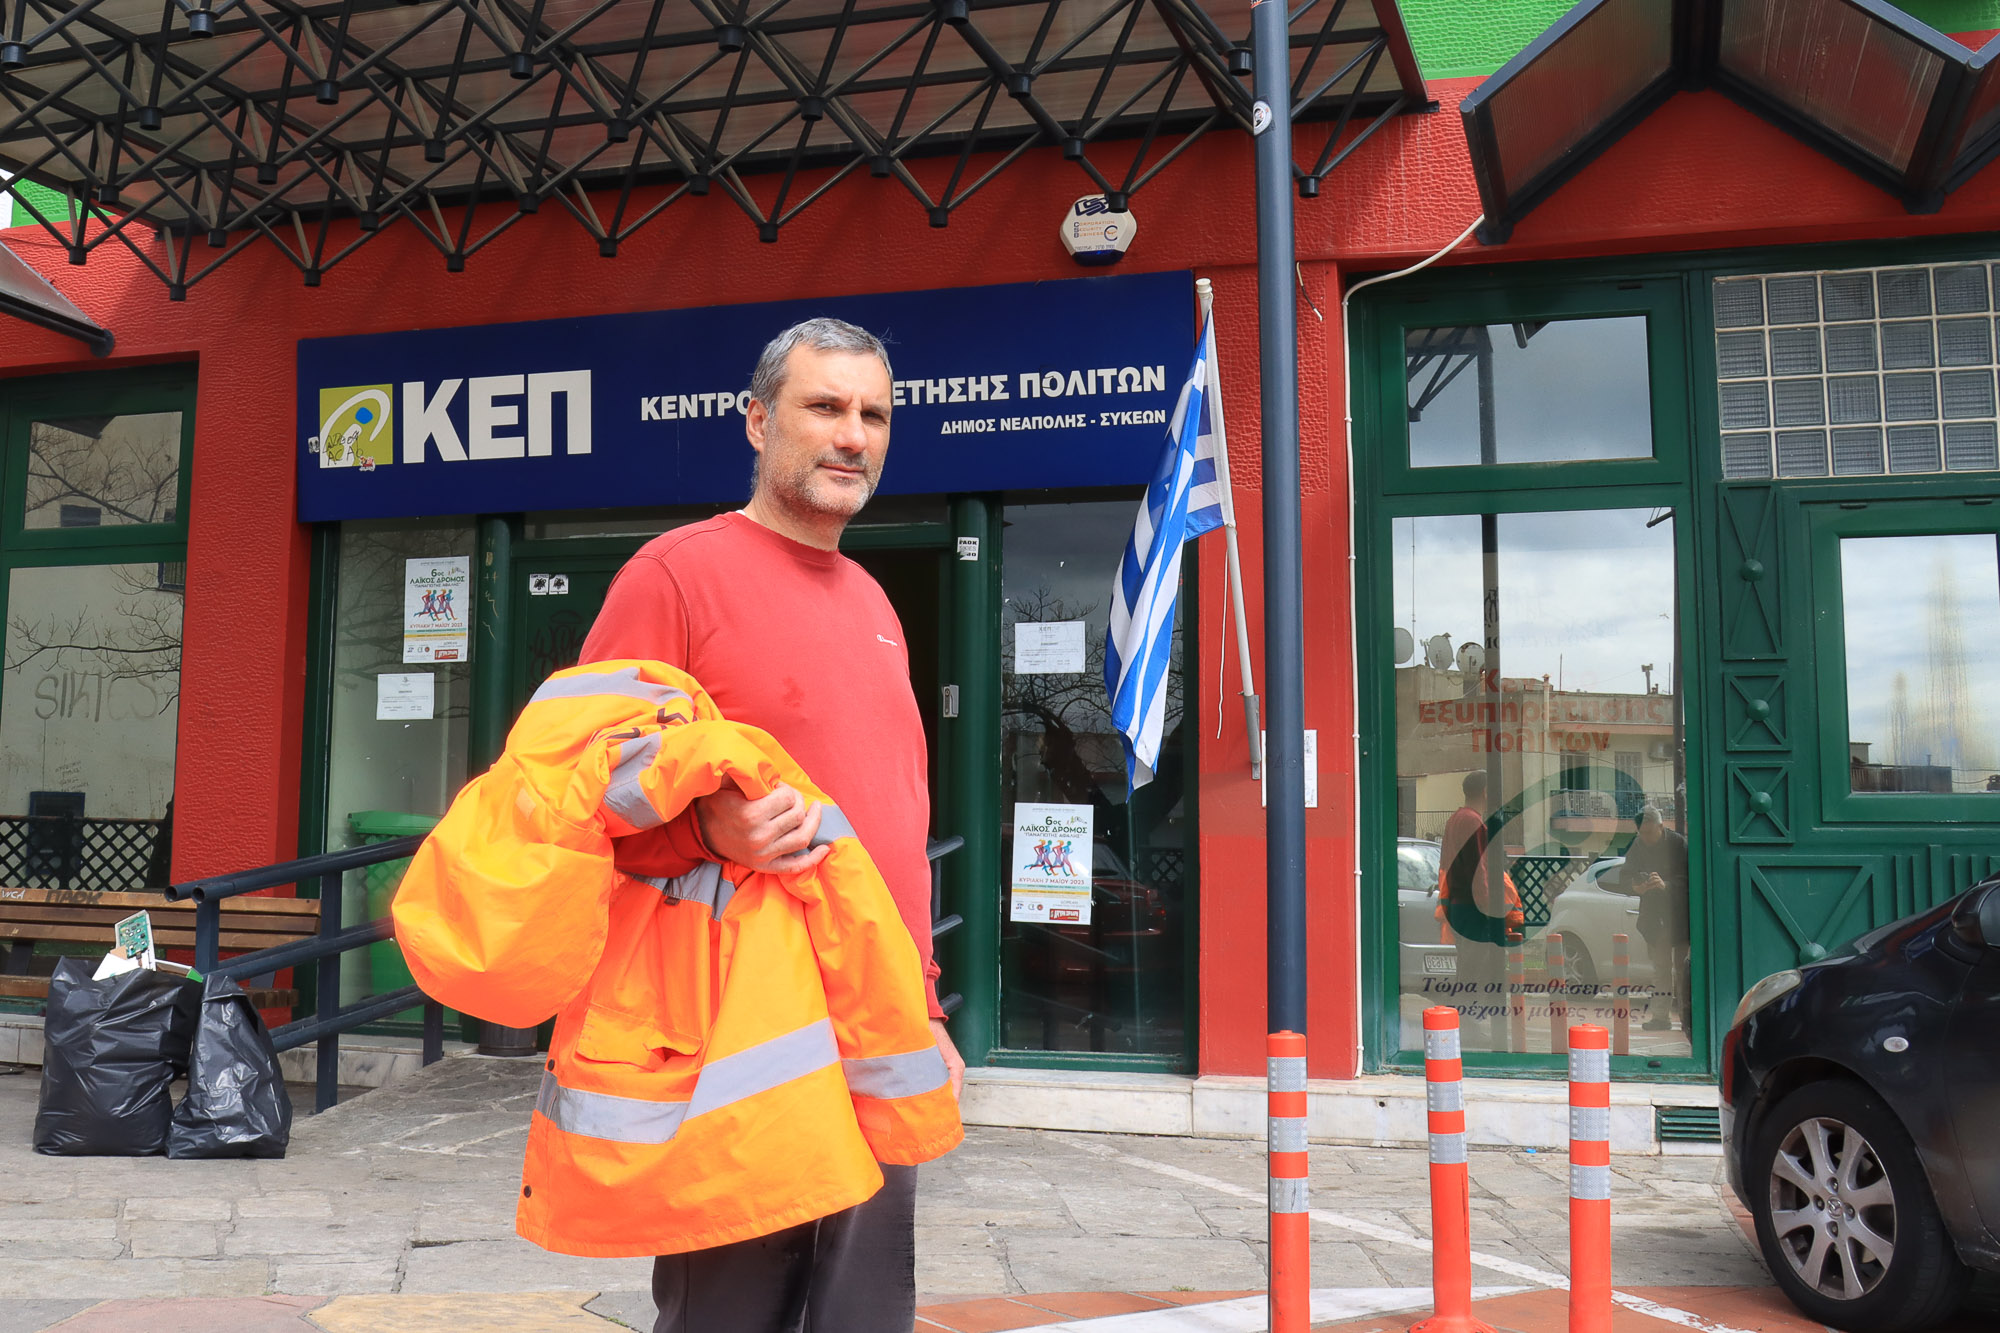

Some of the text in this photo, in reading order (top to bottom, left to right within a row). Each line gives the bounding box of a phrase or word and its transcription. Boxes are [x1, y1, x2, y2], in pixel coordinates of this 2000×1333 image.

[641, 365, 1165, 421] ΚΕΝΤΡΟ ΕΤΗΣΗΣ ΠΟΛΙΤΩΝ
[402, 369, 592, 464] ΚΕΠ
[941, 418, 996, 435] ΔΗΜΟΣ
[1000, 413, 1087, 431] ΝΕΑΠΟΛΗΣ
[1100, 409, 1166, 426] ΣΥΚΕΩΝ
[436, 575, 465, 583] ΔΡΟΜΟΣ
[1472, 724, 1610, 753] Πολιτών
[1019, 824, 1050, 832] ΛΑΪΚΟΣ
[1045, 816, 1062, 826] 6ος
[1422, 976, 1478, 997] Τώρα
[1484, 982, 1502, 994] οι
[1510, 978, 1610, 997] υποθέσεις
[1527, 1002, 1586, 1021] μόνες
[1595, 1003, 1649, 1021] τους!
